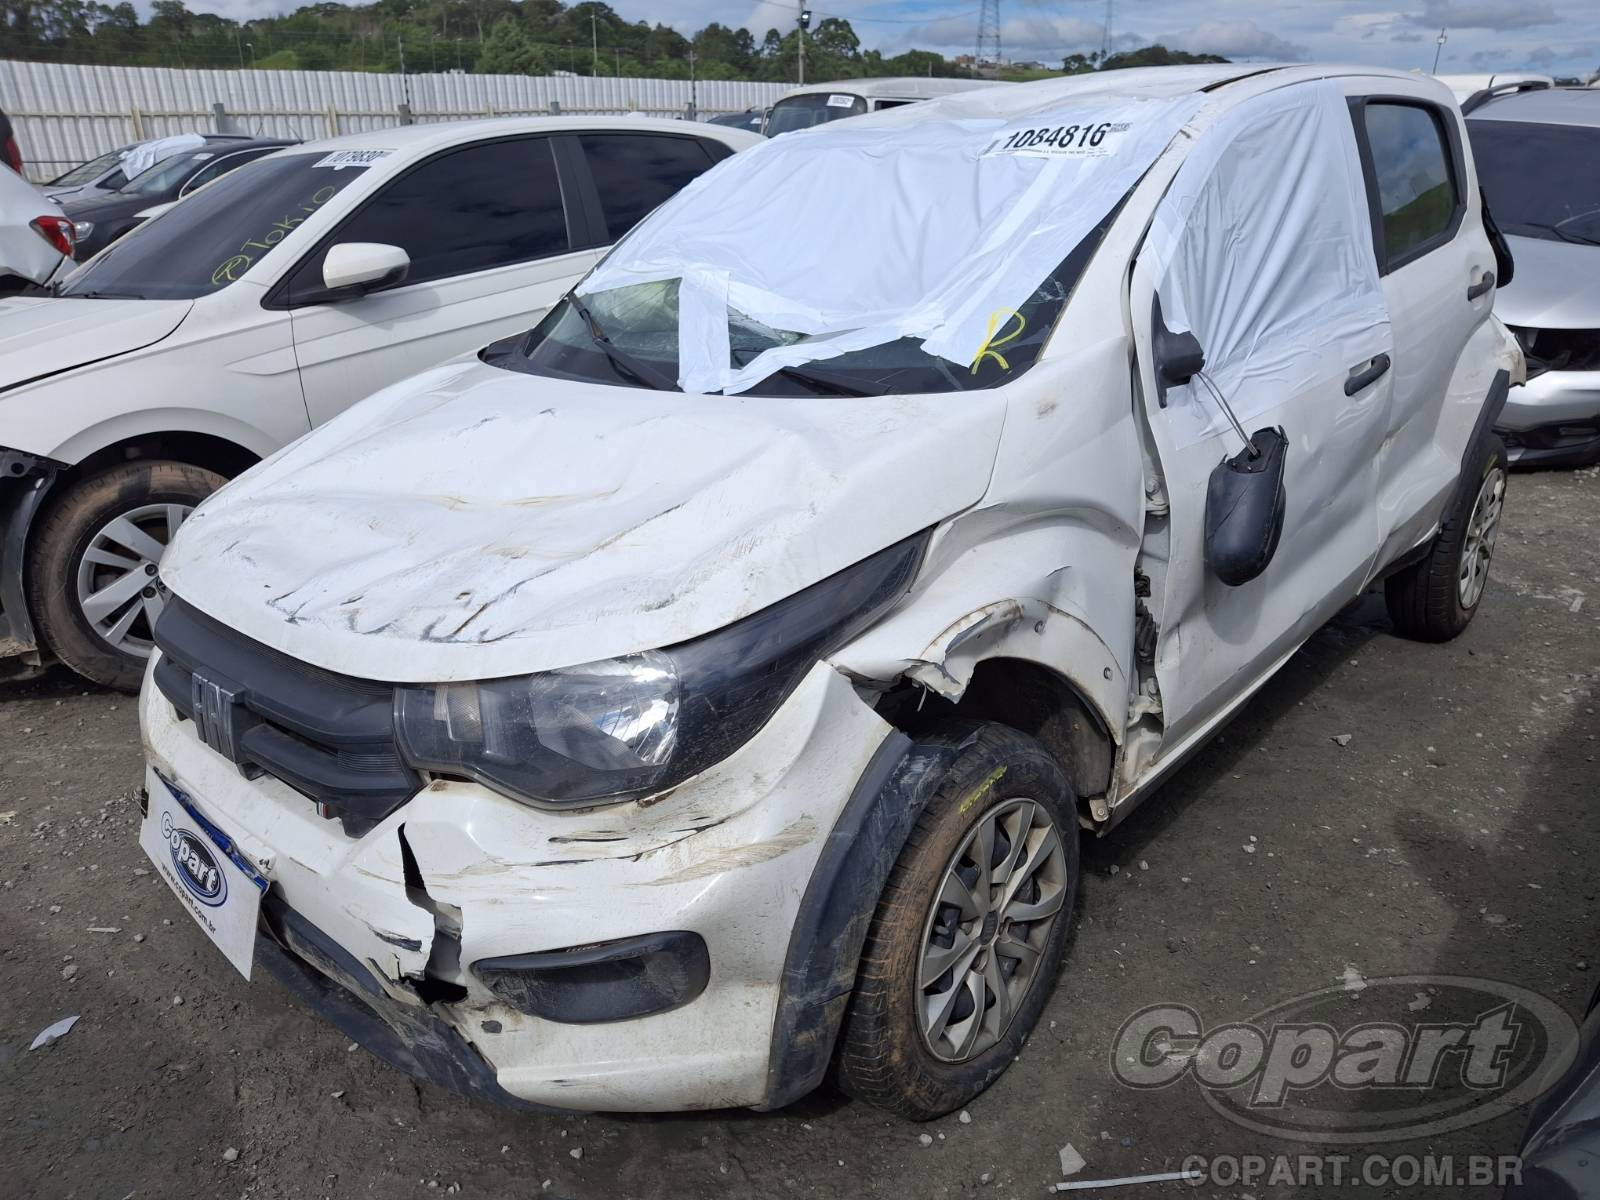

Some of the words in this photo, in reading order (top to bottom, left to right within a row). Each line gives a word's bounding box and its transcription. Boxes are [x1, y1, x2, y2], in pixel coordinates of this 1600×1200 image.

[1003, 122, 1111, 149] 1084816
[971, 308, 1026, 375] R
[161, 811, 218, 893] Copart
[161, 863, 216, 934] www.copart.com.br
